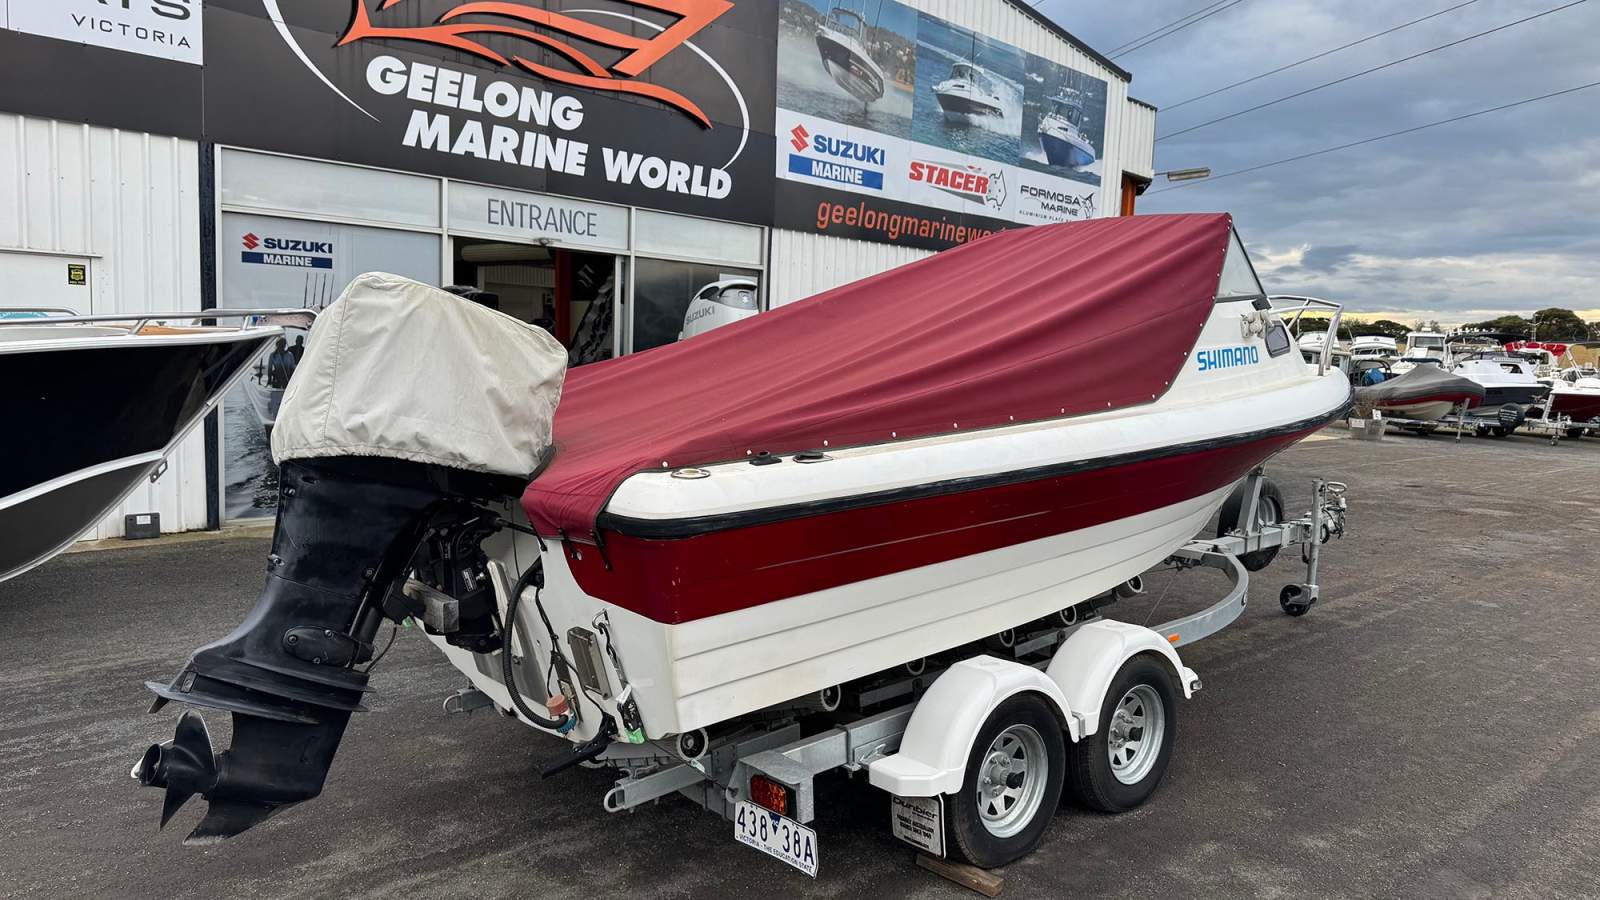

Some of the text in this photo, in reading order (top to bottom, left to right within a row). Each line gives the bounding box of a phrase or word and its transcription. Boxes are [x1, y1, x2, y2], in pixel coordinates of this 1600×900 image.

[72, 14, 191, 49] VICTORIA
[366, 55, 584, 131] GEELONG
[402, 110, 732, 200] MARINE WORLD
[813, 133, 885, 166] SUZUKI
[811, 160, 863, 185] MARINE
[908, 161, 990, 194] STACER
[1020, 185, 1081, 206] FORMOSA
[1041, 202, 1079, 216] MARINE
[487, 198, 597, 237] ENTRANCE
[263, 238, 333, 254] SUZUKI
[263, 254, 313, 267] MARINE
[686, 306, 714, 324] SUZUKI
[1197, 345, 1259, 371] SHIMANO
[737, 806, 814, 865] 438 38A
